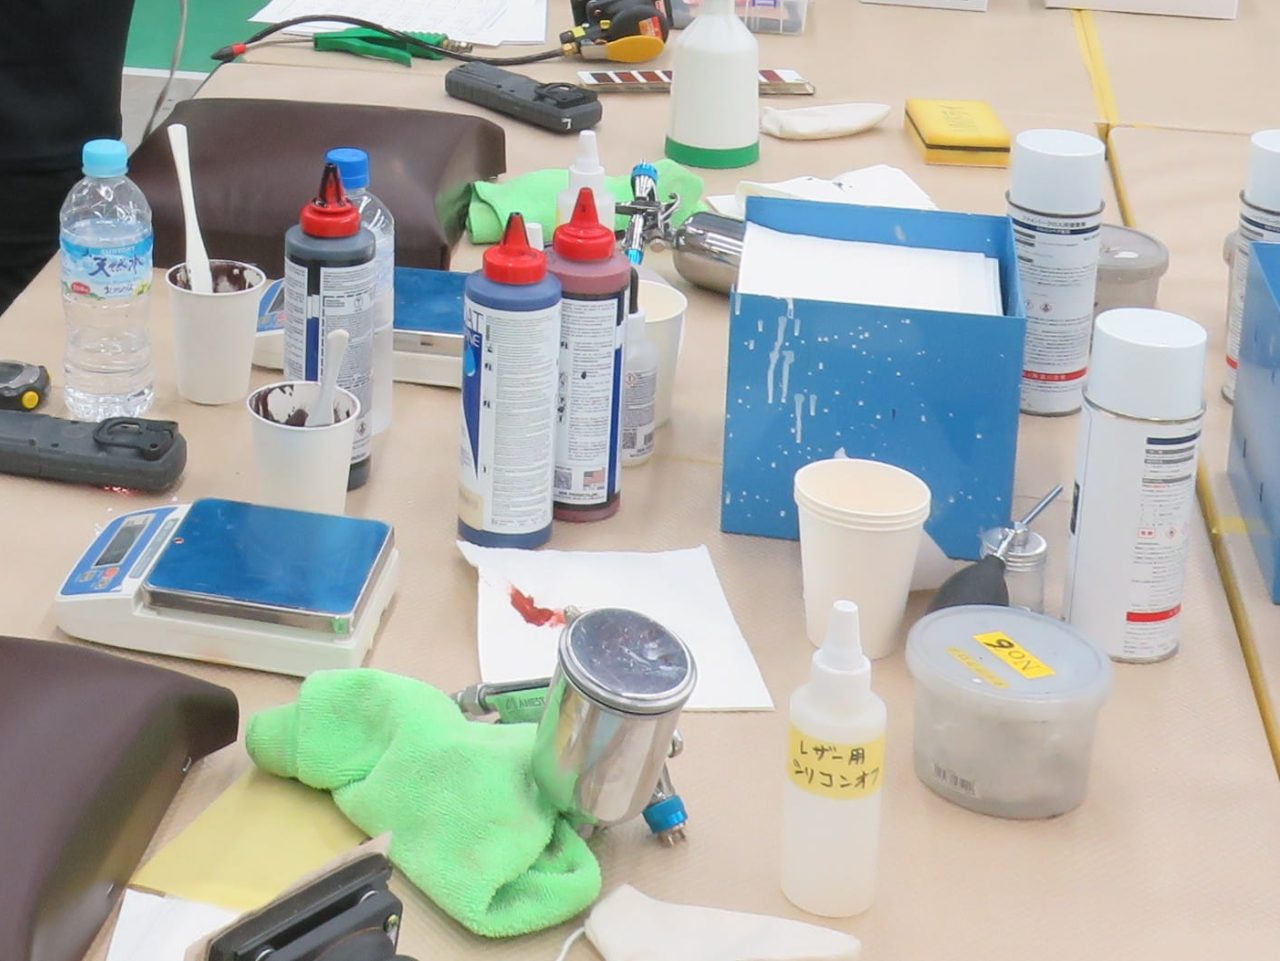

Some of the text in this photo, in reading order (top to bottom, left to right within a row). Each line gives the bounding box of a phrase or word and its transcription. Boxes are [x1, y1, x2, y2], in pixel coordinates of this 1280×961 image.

[87, 252, 144, 278] 天然水
[799, 740, 866, 766] レザー用
[792, 758, 880, 789] シリコンオフ
